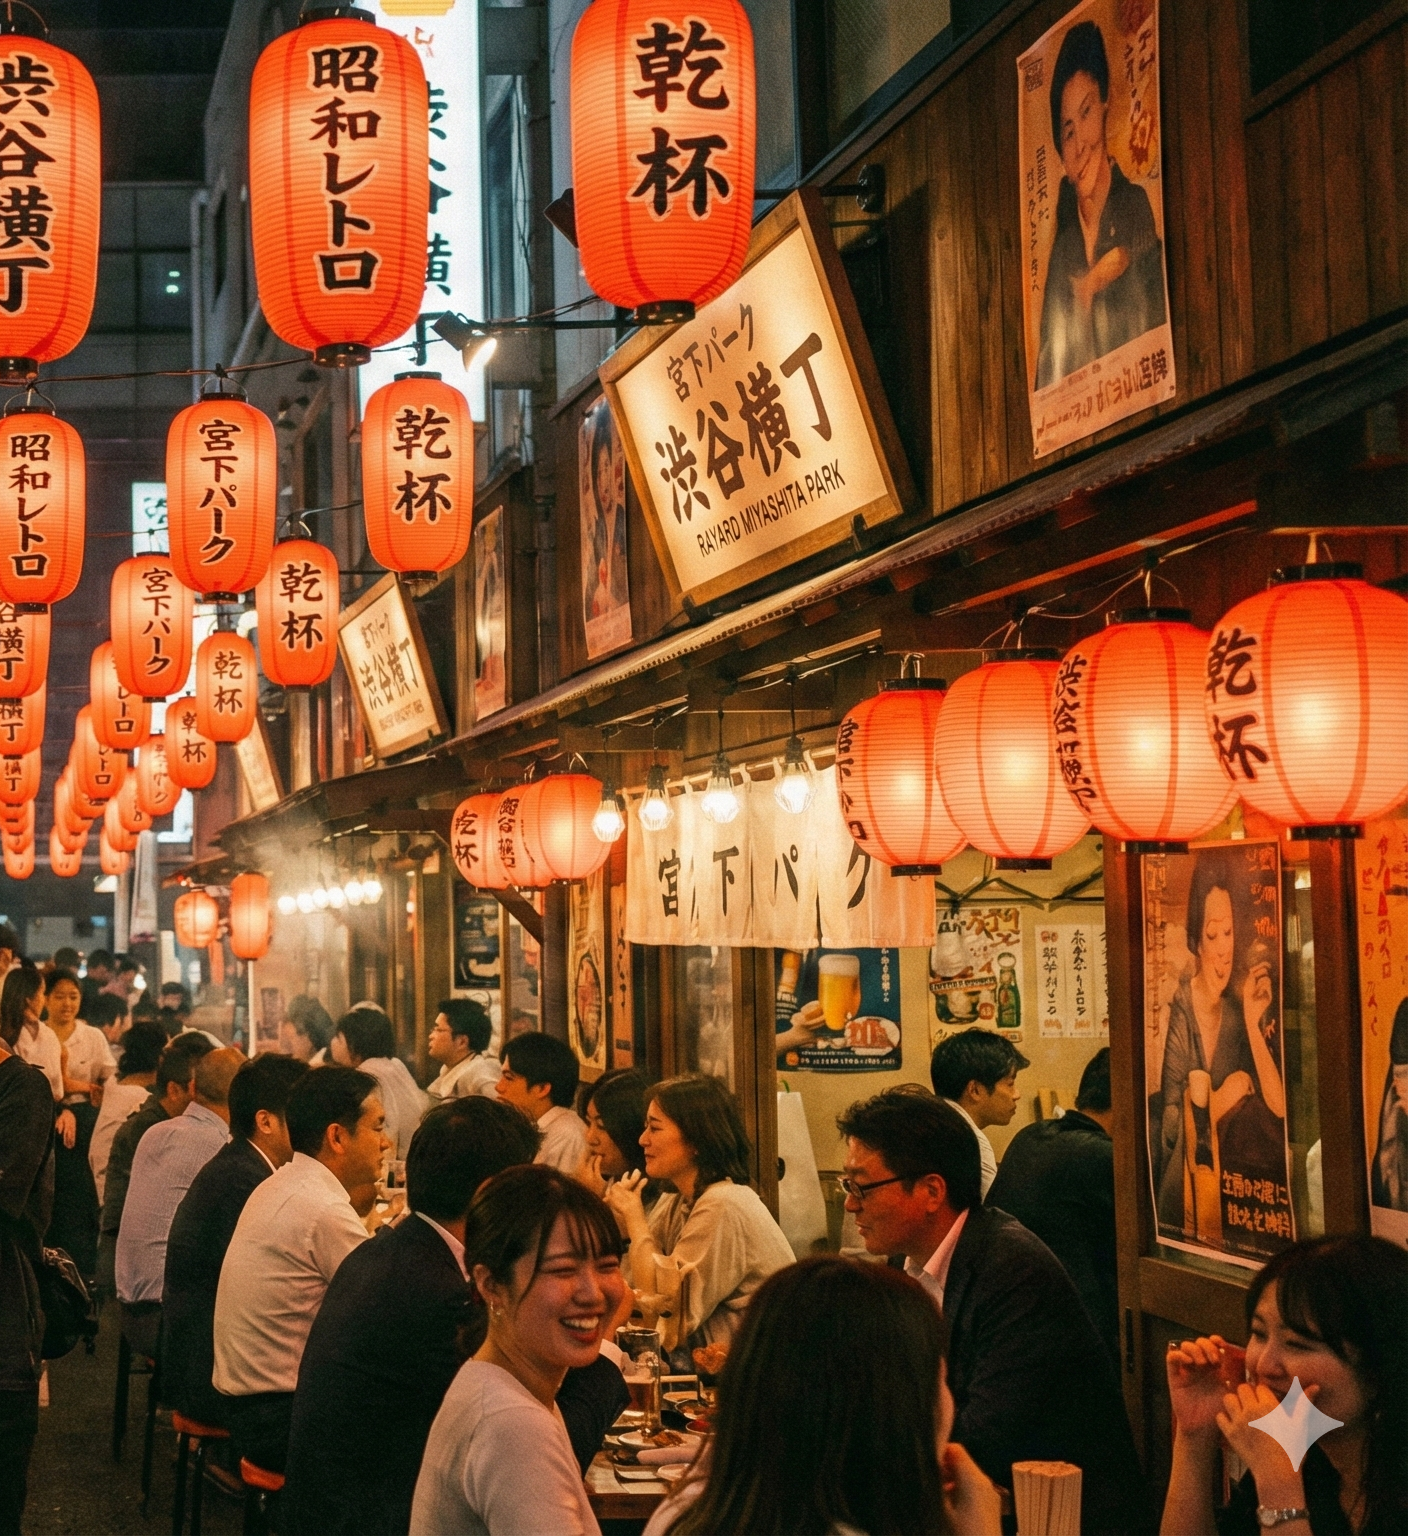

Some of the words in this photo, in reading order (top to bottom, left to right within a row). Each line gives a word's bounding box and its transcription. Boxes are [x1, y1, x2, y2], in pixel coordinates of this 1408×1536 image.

[311, 45, 380, 290] 昭和レトロ
[630, 20, 730, 217] 乾杯
[667, 303, 754, 402] 宮下パーク
[199, 420, 241, 564] 宮下パーク
[392, 407, 452, 523] 乾杯
[655, 332, 832, 524] 渋谷横丁
[9, 434, 51, 577] 昭和レトロ
[697, 515, 741, 557] RAYARD
[739, 480, 808, 535] MIYASHITA
[805, 458, 846, 502] PARK
[142, 567, 173, 675] 宮下パーク
[279, 562, 324, 650] 乾杯
[213, 651, 243, 714] 乾杯
[1205, 627, 1271, 781] 乾杯
